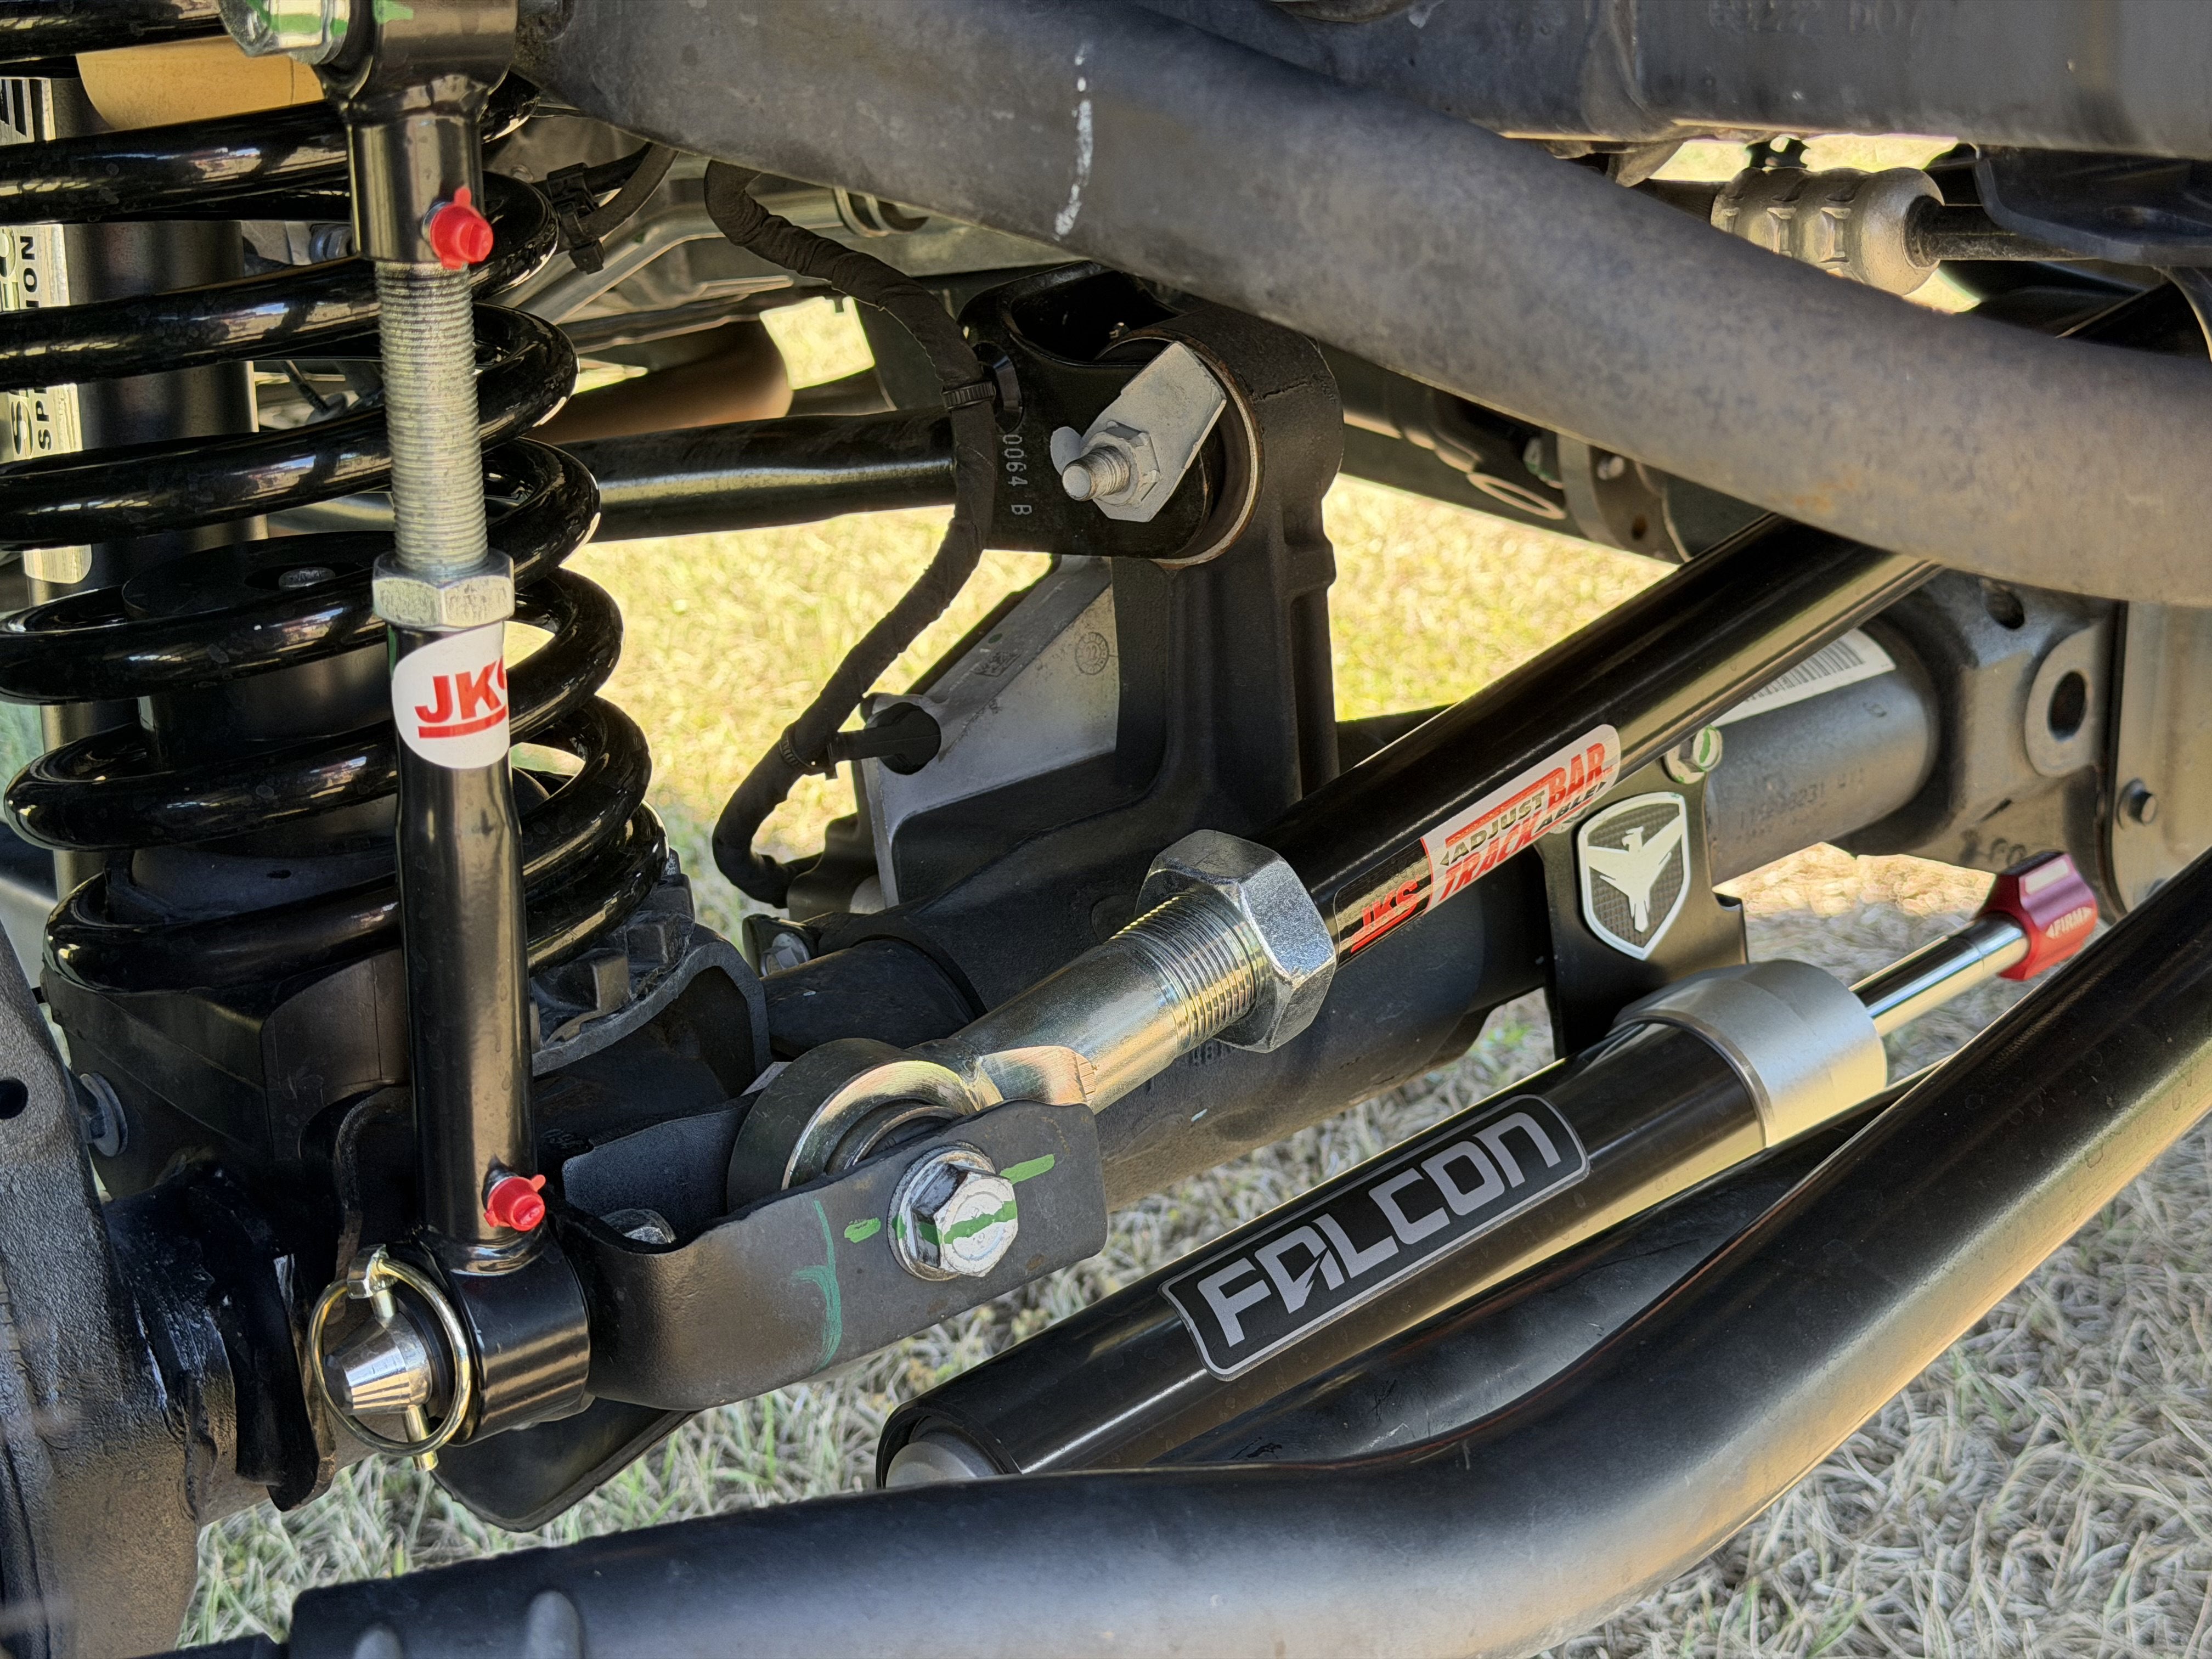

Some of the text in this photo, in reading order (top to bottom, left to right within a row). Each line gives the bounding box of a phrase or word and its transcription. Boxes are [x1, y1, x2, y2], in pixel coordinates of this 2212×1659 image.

[1002, 434, 1032, 515] 0064 B
[1547, 742, 1605, 809] BAR
[1438, 809, 1543, 902] TRACK
[1451, 789, 1545, 865] ADJUST
[1351, 878, 1420, 940] JKS
[1197, 1111, 1561, 1348] FALCON
